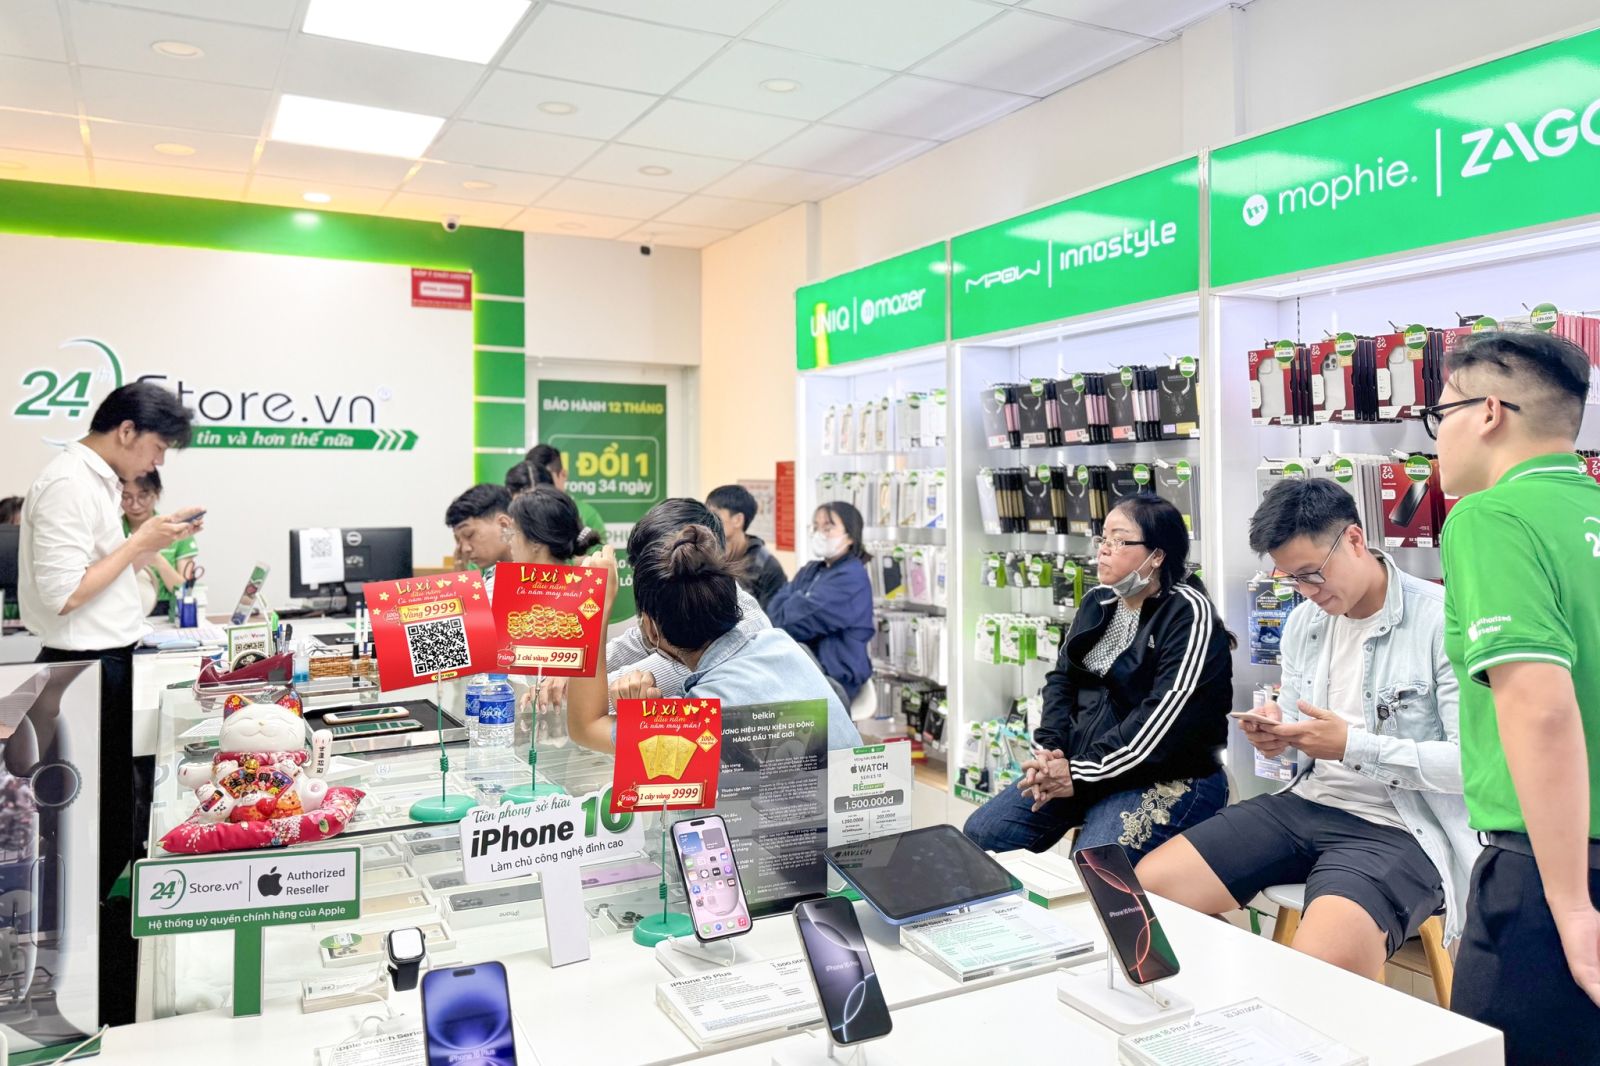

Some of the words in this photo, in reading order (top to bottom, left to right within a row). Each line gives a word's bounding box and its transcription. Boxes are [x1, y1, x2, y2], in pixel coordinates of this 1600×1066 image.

[964, 259, 1041, 293] MPOW
[1059, 219, 1177, 272] innostyle
[810, 304, 850, 337] UNIQ
[874, 287, 926, 320] mazer
[543, 396, 570, 411] BẢO
[571, 397, 607, 413] HÀNH
[608, 401, 622, 414] 12
[623, 401, 664, 415] THÁNG
[227, 431, 248, 446] và
[252, 430, 286, 446] hơn
[291, 430, 323, 447] thế
[323, 434, 354, 447] nữa
[576, 441, 630, 477] ĐỔI
[635, 452, 649, 477] 1
[1591, 460, 1600, 468] Z
[1382, 465, 1393, 473] ZA
[1591, 467, 1600, 476] G
[564, 482, 596, 496] rong
[597, 478, 618, 492] 34
[619, 478, 653, 496] ngày
[545, 590, 562, 600] may
[424, 601, 457, 617] 9999
[517, 653, 522, 661] 1
[550, 651, 578, 663] 9999
[751, 710, 776, 721] belkin
[720, 727, 740, 736] ƯƠNG
[796, 720, 815, 728] ĐỘNG
[858, 762, 889, 773] WATCH
[672, 787, 699, 799] 9999
[472, 809, 496, 824] Tiên
[497, 804, 532, 823] phong
[470, 819, 575, 859] iPhone
[491, 862, 513, 873] Làm
[514, 855, 534, 869] chủ
[534, 851, 559, 865] công
[560, 847, 584, 862] nghệ
[607, 839, 624, 850] cao
[286, 868, 346, 882] Authorized
[189, 878, 240, 894] Store.vn
[286, 884, 330, 896] Reseller
[148, 920, 163, 931] Hệ
[164, 916, 194, 930] thống
[209, 912, 241, 926] quyền
[242, 910, 271, 923] chính
[298, 907, 317, 918] của
[318, 905, 346, 918] Apple
[670, 978, 702, 988] iPhone
[1132, 1031, 1162, 1045] iPhone
[449, 1053, 473, 1063] iPhone
[482, 1048, 496, 1058] Plus
